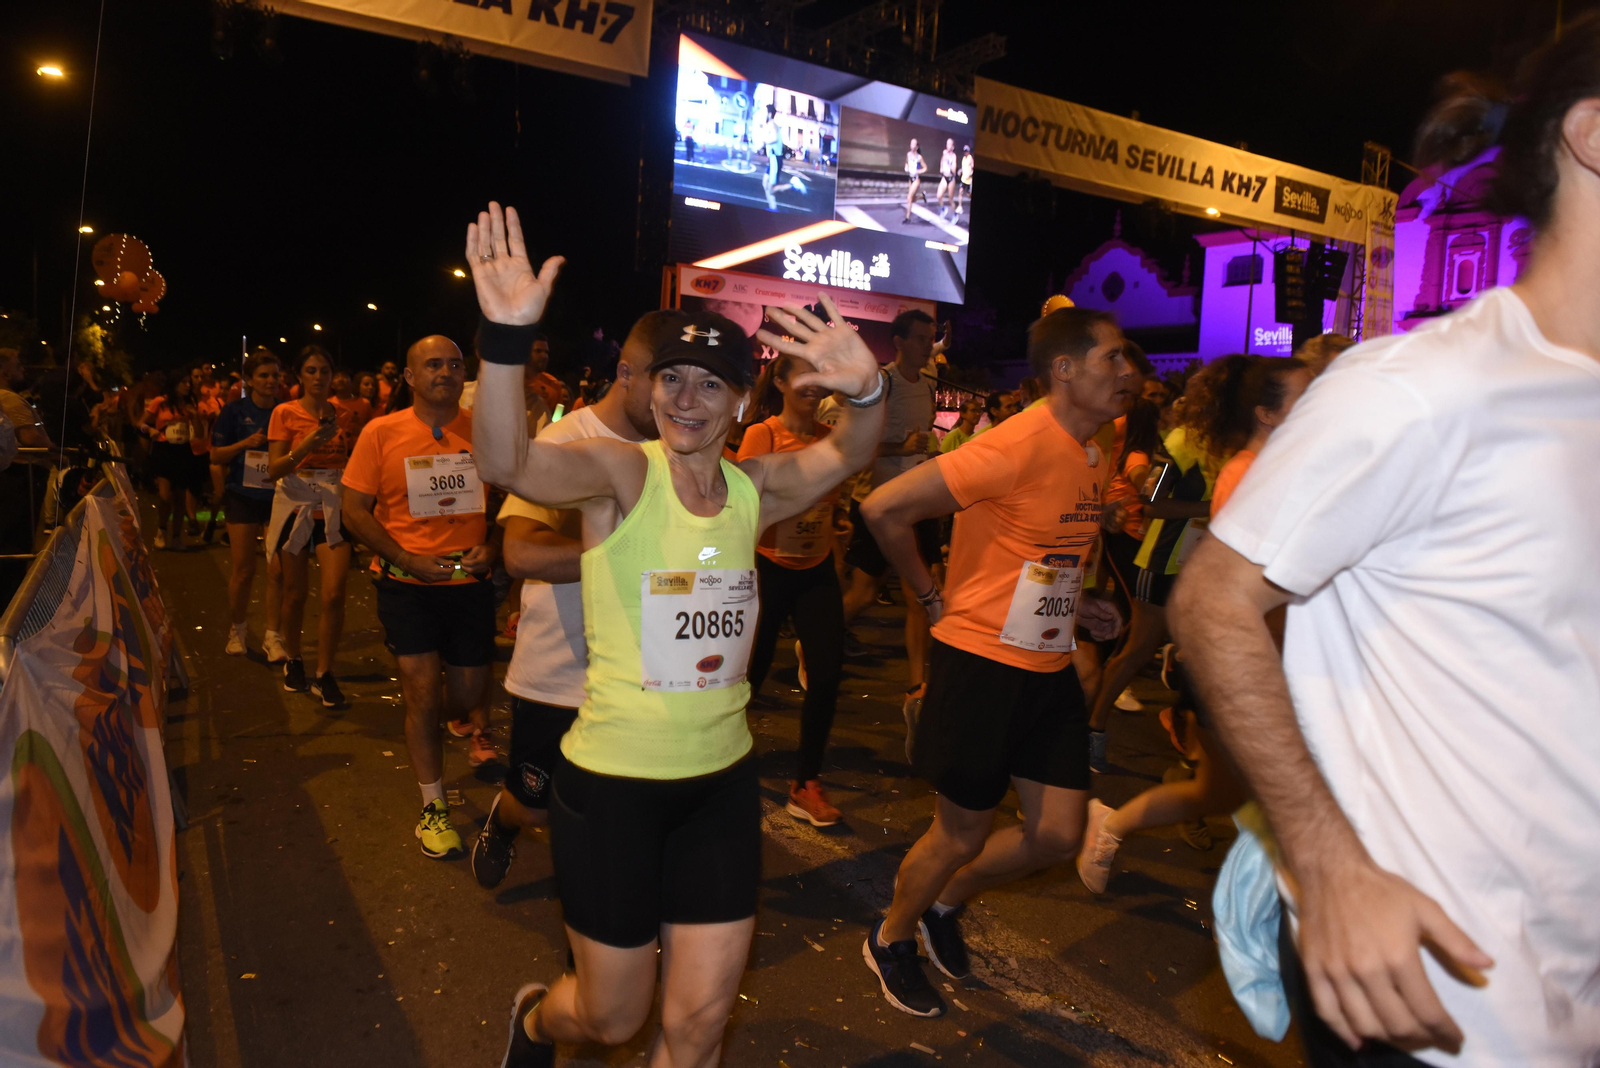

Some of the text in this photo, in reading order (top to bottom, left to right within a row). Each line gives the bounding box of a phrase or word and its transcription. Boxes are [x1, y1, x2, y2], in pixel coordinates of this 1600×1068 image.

[980, 105, 1119, 165] NOCTURNA
[1125, 144, 1214, 189] SEVILLA
[732, 284, 748, 292] ABC
[755, 288, 786, 298] Cruzcampo
[429, 474, 466, 491] 3608
[1059, 513, 1089, 523] SEVILLA
[675, 610, 744, 640] 20865
